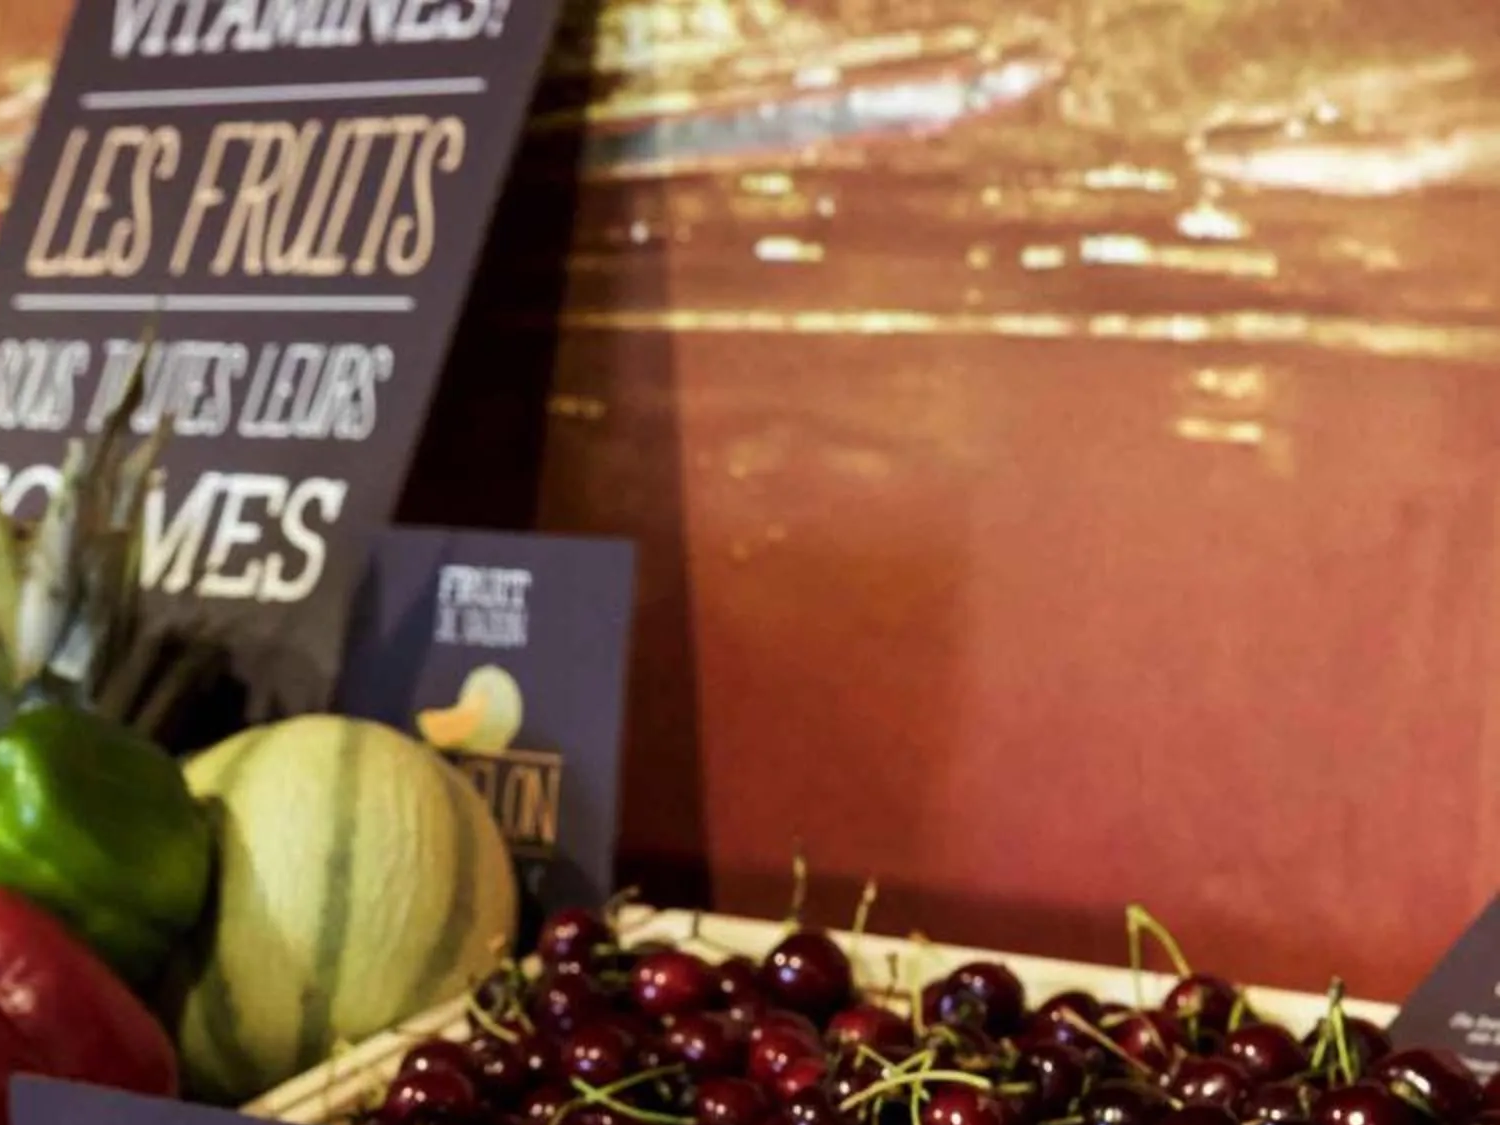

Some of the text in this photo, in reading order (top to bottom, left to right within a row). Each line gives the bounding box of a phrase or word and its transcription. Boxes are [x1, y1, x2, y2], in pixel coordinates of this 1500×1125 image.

[26, 115, 466, 277] LES FRUITS
[85, 339, 249, 436] TUTES
[237, 342, 394, 441] LEURS
